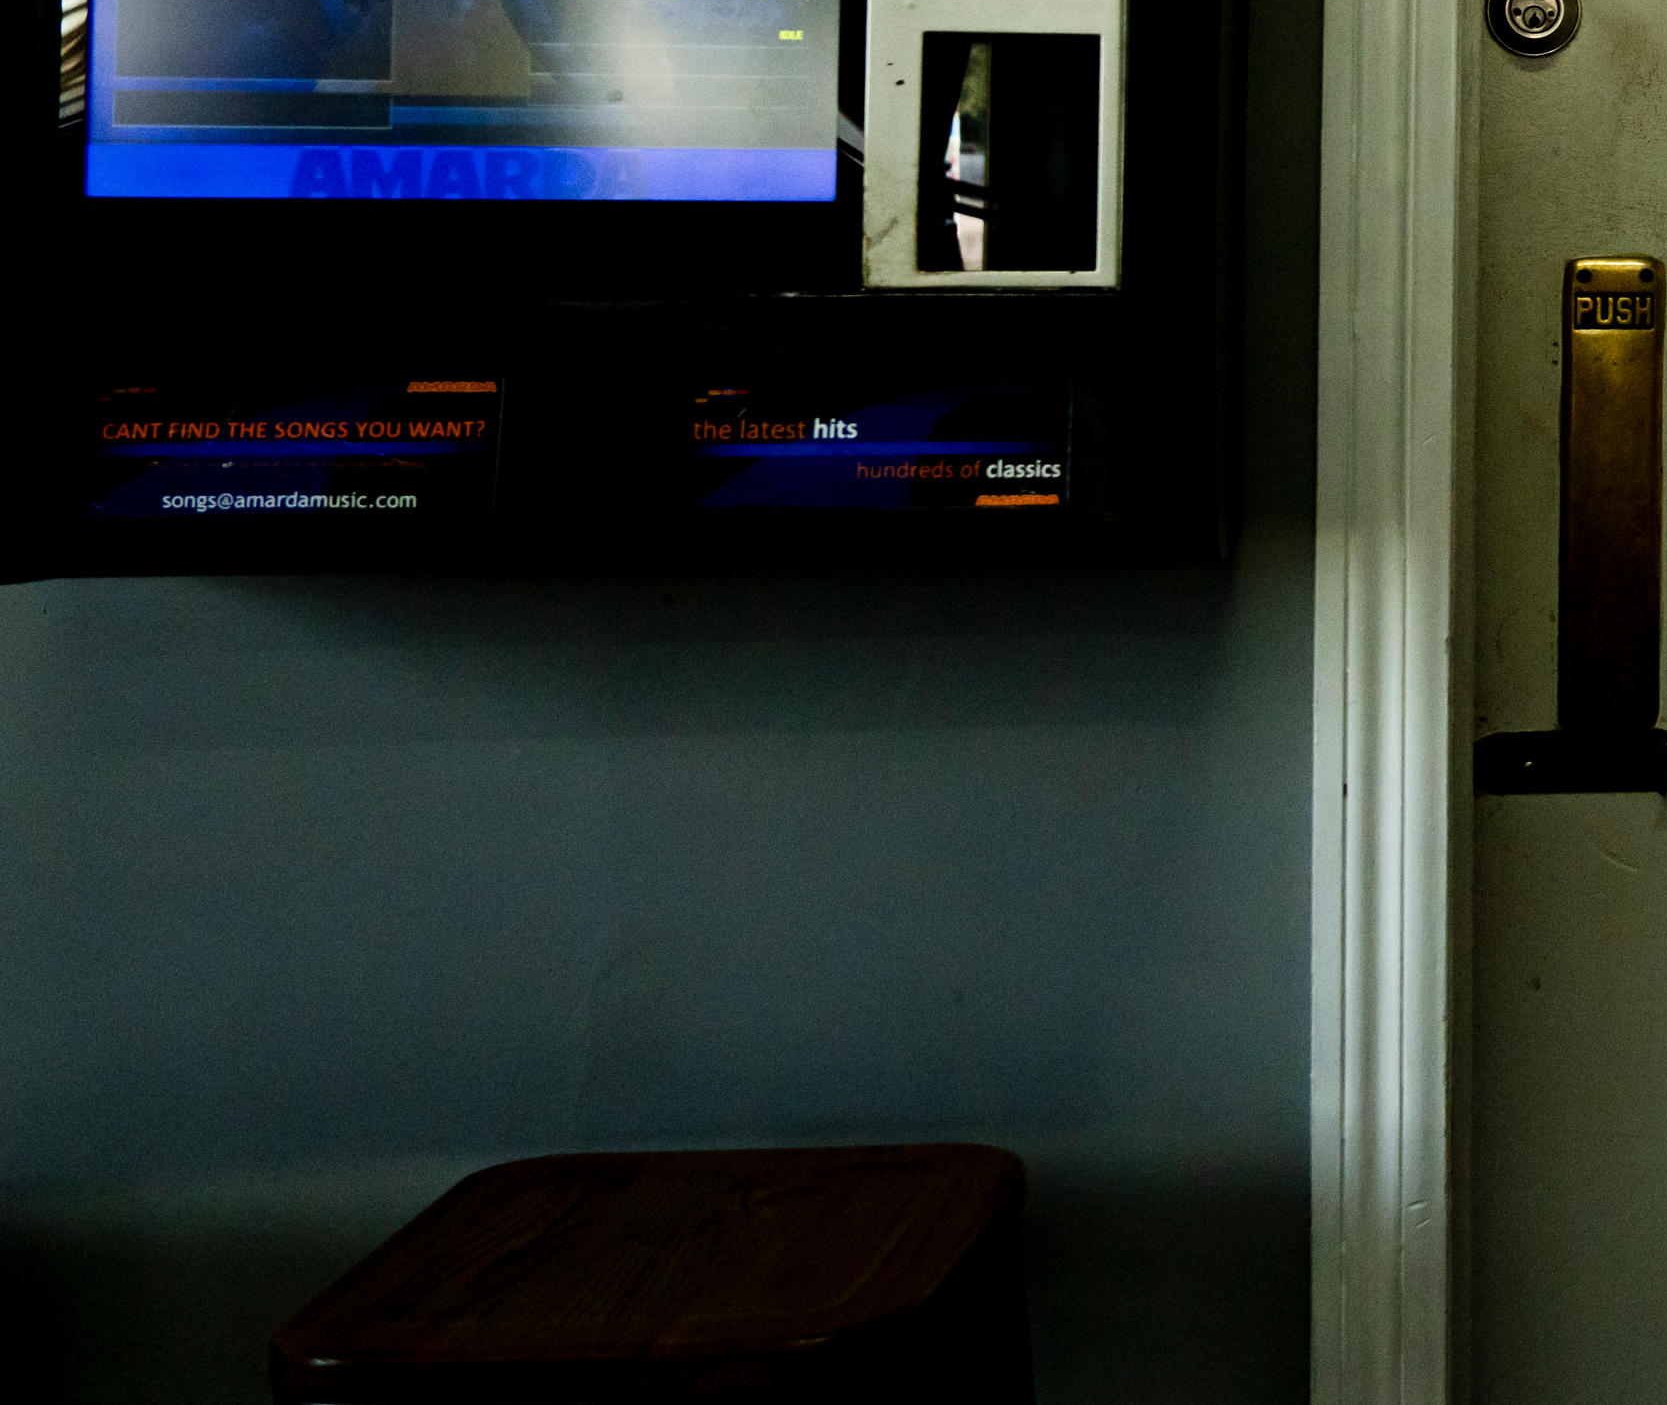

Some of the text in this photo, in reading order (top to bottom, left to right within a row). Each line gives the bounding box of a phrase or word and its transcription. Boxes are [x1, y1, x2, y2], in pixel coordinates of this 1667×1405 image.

[1575, 295, 1653, 326] PUSH
[102, 420, 486, 440] CANT FIND THE SONGS YOU WANT?
[693, 419, 858, 440] the latest hits
[856, 460, 1062, 479] hundreds of classics
[162, 491, 417, 512] songs@amardamusic.com
